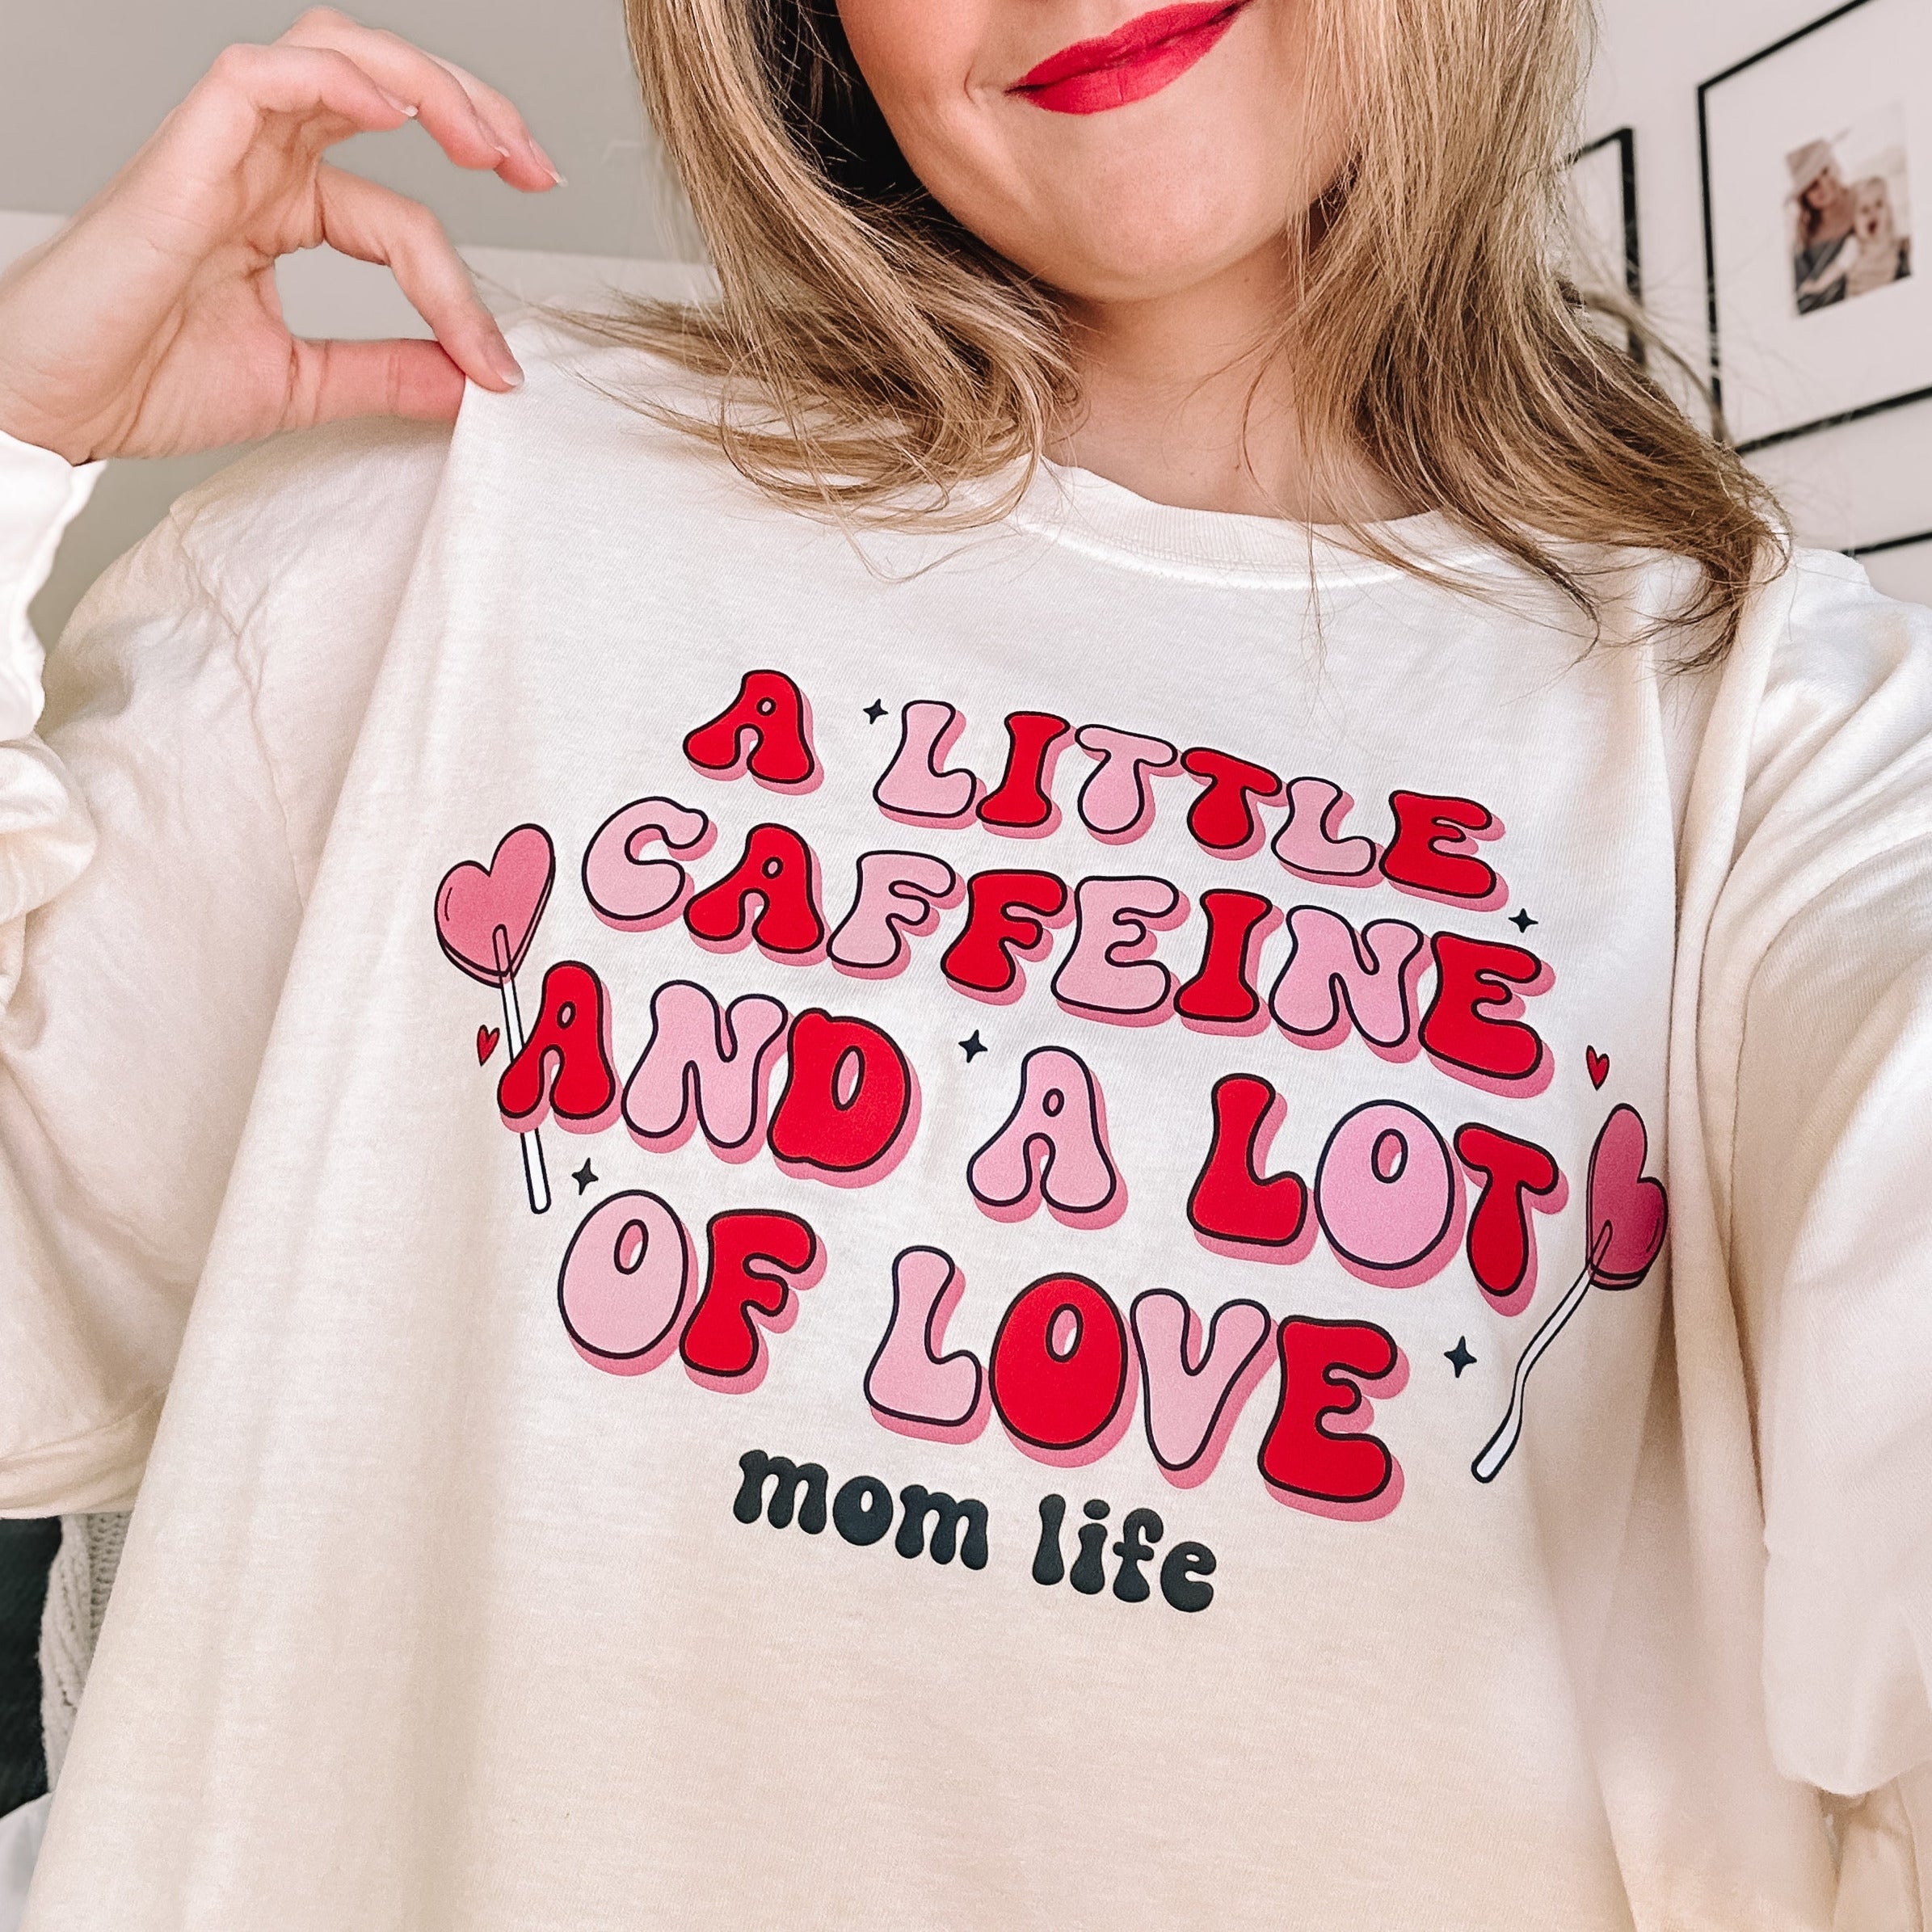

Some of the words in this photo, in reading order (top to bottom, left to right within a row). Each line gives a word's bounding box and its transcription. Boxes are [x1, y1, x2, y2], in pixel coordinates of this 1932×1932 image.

[683, 670, 824, 796] A
[873, 700, 1509, 912] LITTLE
[582, 796, 1556, 1099] CAFFEINE
[496, 961, 922, 1187] AND
[966, 1046, 1128, 1231] A
[1186, 1073, 1569, 1318] LOT
[558, 1189, 827, 1395] OF
[864, 1245, 1410, 1522] LOVE
[733, 1450, 988, 1570] mom
[1033, 1494, 1216, 1613] life
